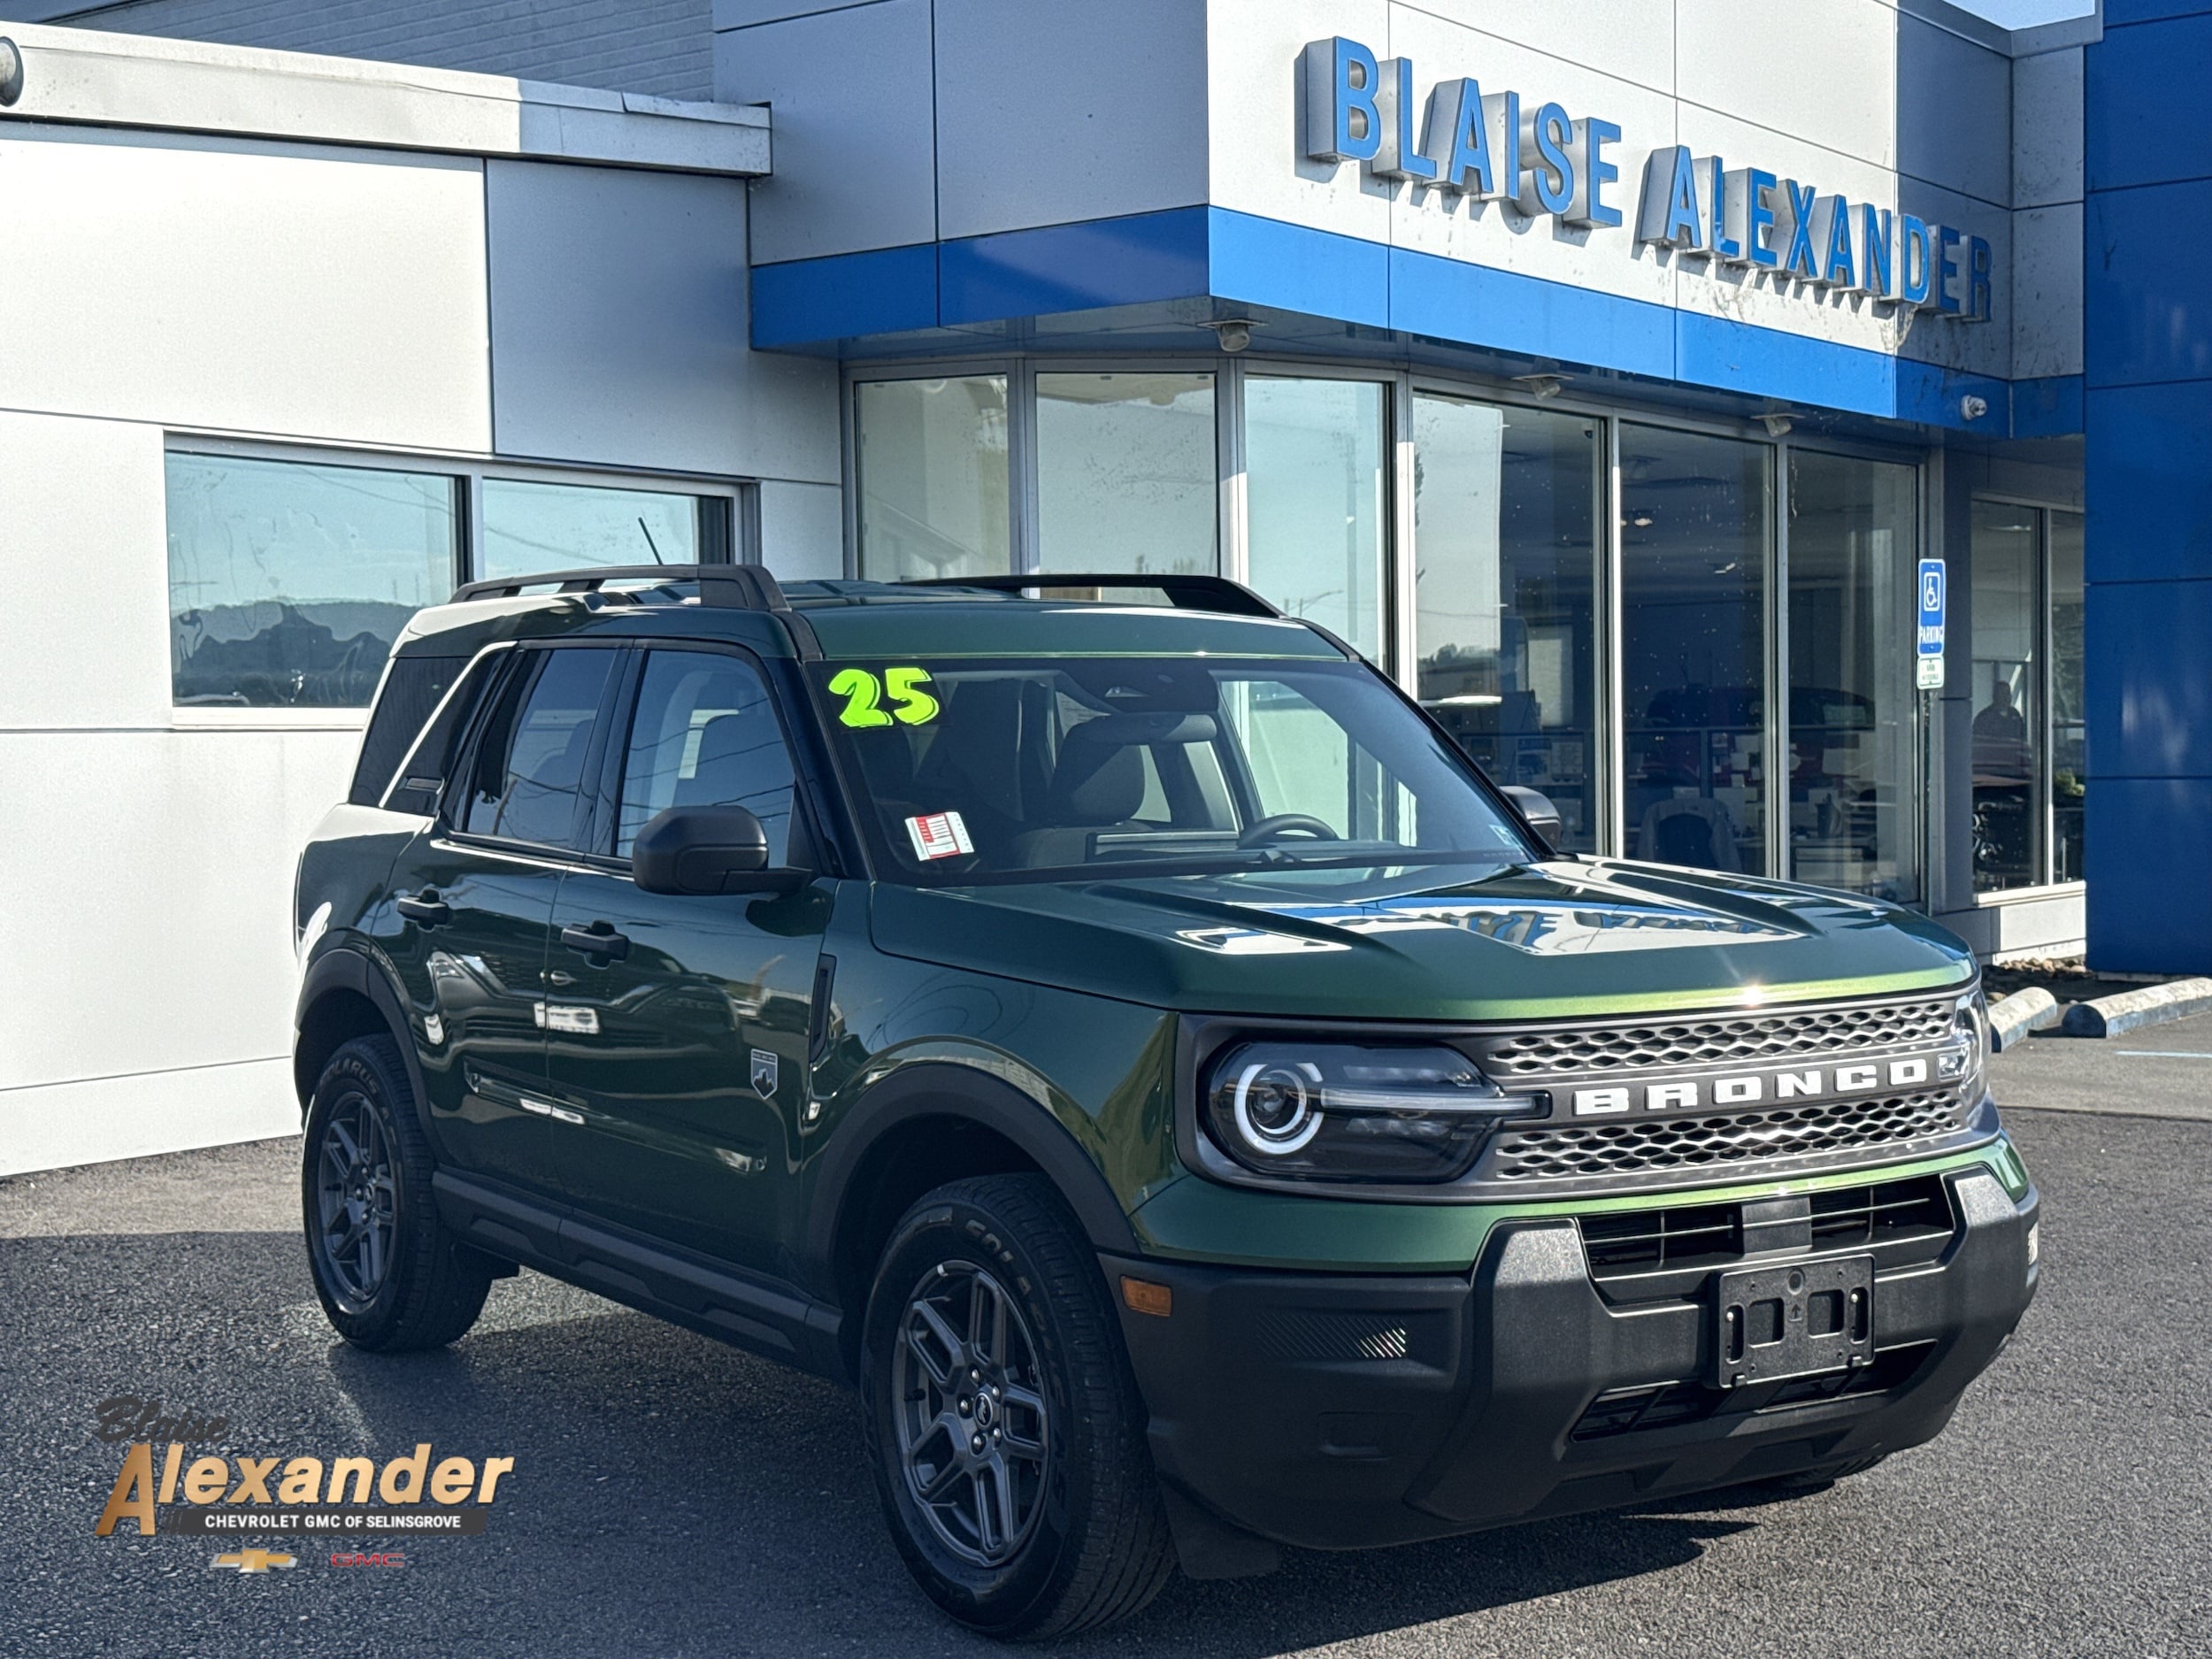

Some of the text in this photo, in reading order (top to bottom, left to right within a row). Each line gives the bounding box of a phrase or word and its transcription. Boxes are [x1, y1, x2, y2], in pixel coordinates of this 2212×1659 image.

[1327, 35, 1993, 323] BLAISE ALEXANDER
[1919, 626, 1944, 645] PARKING
[828, 667, 940, 728] 25
[1573, 1058, 1927, 1117] BRONCO
